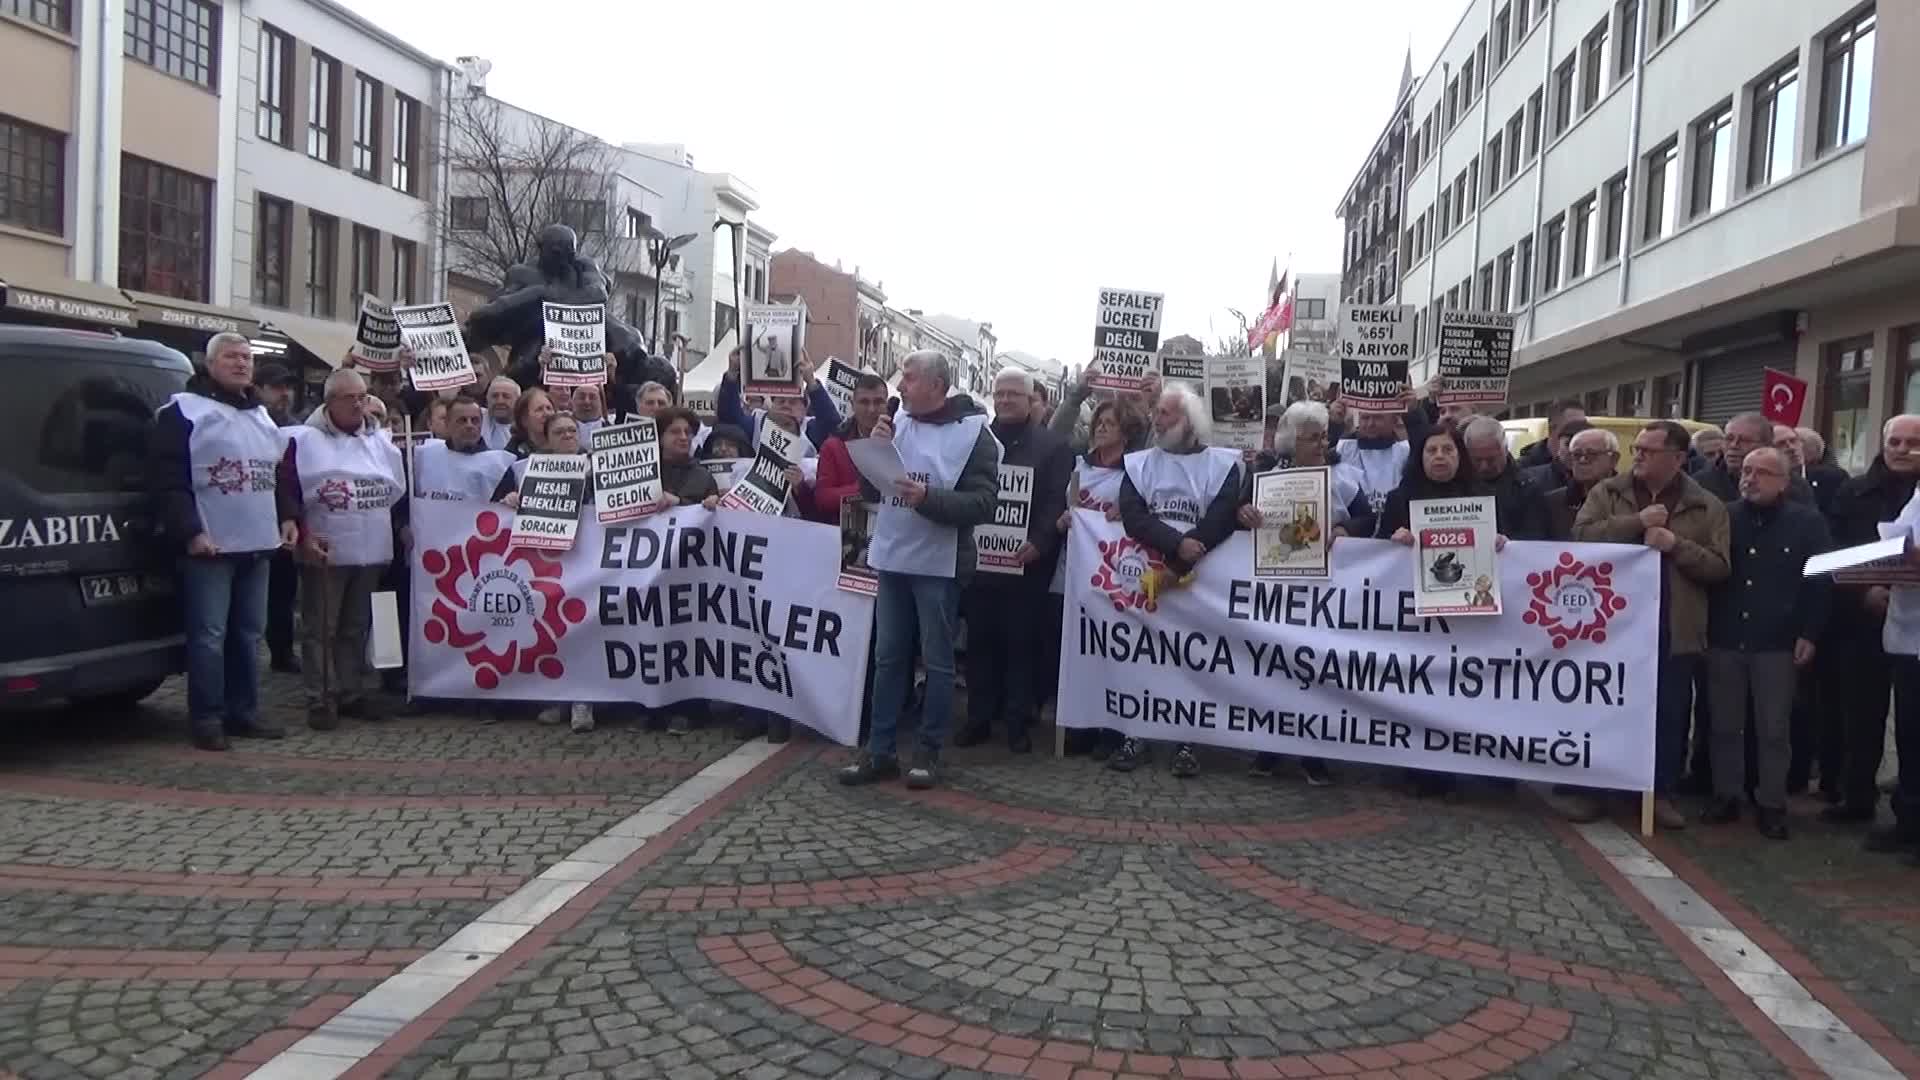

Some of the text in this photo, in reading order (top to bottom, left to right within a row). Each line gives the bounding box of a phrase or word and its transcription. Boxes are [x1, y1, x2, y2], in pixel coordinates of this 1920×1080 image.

[16, 293, 131, 324] YAŞAR KUYUMCULUK
[1100, 291, 1161, 311] SEFALET
[548, 309, 600, 323] 17 MİLYON
[1102, 309, 1154, 329] ÜCRETİ
[408, 330, 459, 352] HAKKIMIZI
[561, 326, 594, 339] EMEKLİ
[1105, 331, 1145, 349] DEĞİL
[548, 337, 602, 355] BİRLEŞEREK
[1358, 343, 1409, 356] ARIYOR
[582, 358, 603, 371] OLUR
[1095, 349, 1151, 366] İNSANCA
[1101, 362, 1143, 379] YAŞAM
[1358, 362, 1389, 377] YADA
[593, 427, 654, 448] EMEKLİYİZ
[769, 429, 792, 456] SÖZ
[529, 458, 585, 473] İKTİDARDAN
[597, 448, 654, 471] PİJAMAYI
[600, 465, 654, 488] ÇIKARDIK
[755, 455, 785, 491] HAKKI
[534, 481, 571, 496] HESABI
[607, 486, 652, 508] GELDİK
[521, 495, 577, 513] EMEKLİLER
[1424, 502, 1483, 515] EMEKLİNİN
[994, 503, 1024, 526] DİRİ
[0, 513, 121, 549] ZABITA
[520, 519, 568, 535] SORACAK
[600, 517, 769, 581] EDİRNE
[1430, 532, 1468, 546] 2026
[1122, 565, 1142, 577] EED
[91, 578, 113, 598] 22
[484, 592, 521, 613] EED
[1562, 594, 1588, 607] EED
[491, 616, 515, 627] 2025
[599, 583, 842, 658] EMEKLİLER
[1079, 606, 1626, 707] İNSANCA YAŞAMAK İSTİYOR!
[604, 639, 794, 698] DERNEĞİ
[1104, 687, 1592, 769] EDİRNE EMEKLİLER DERNEĞİ
